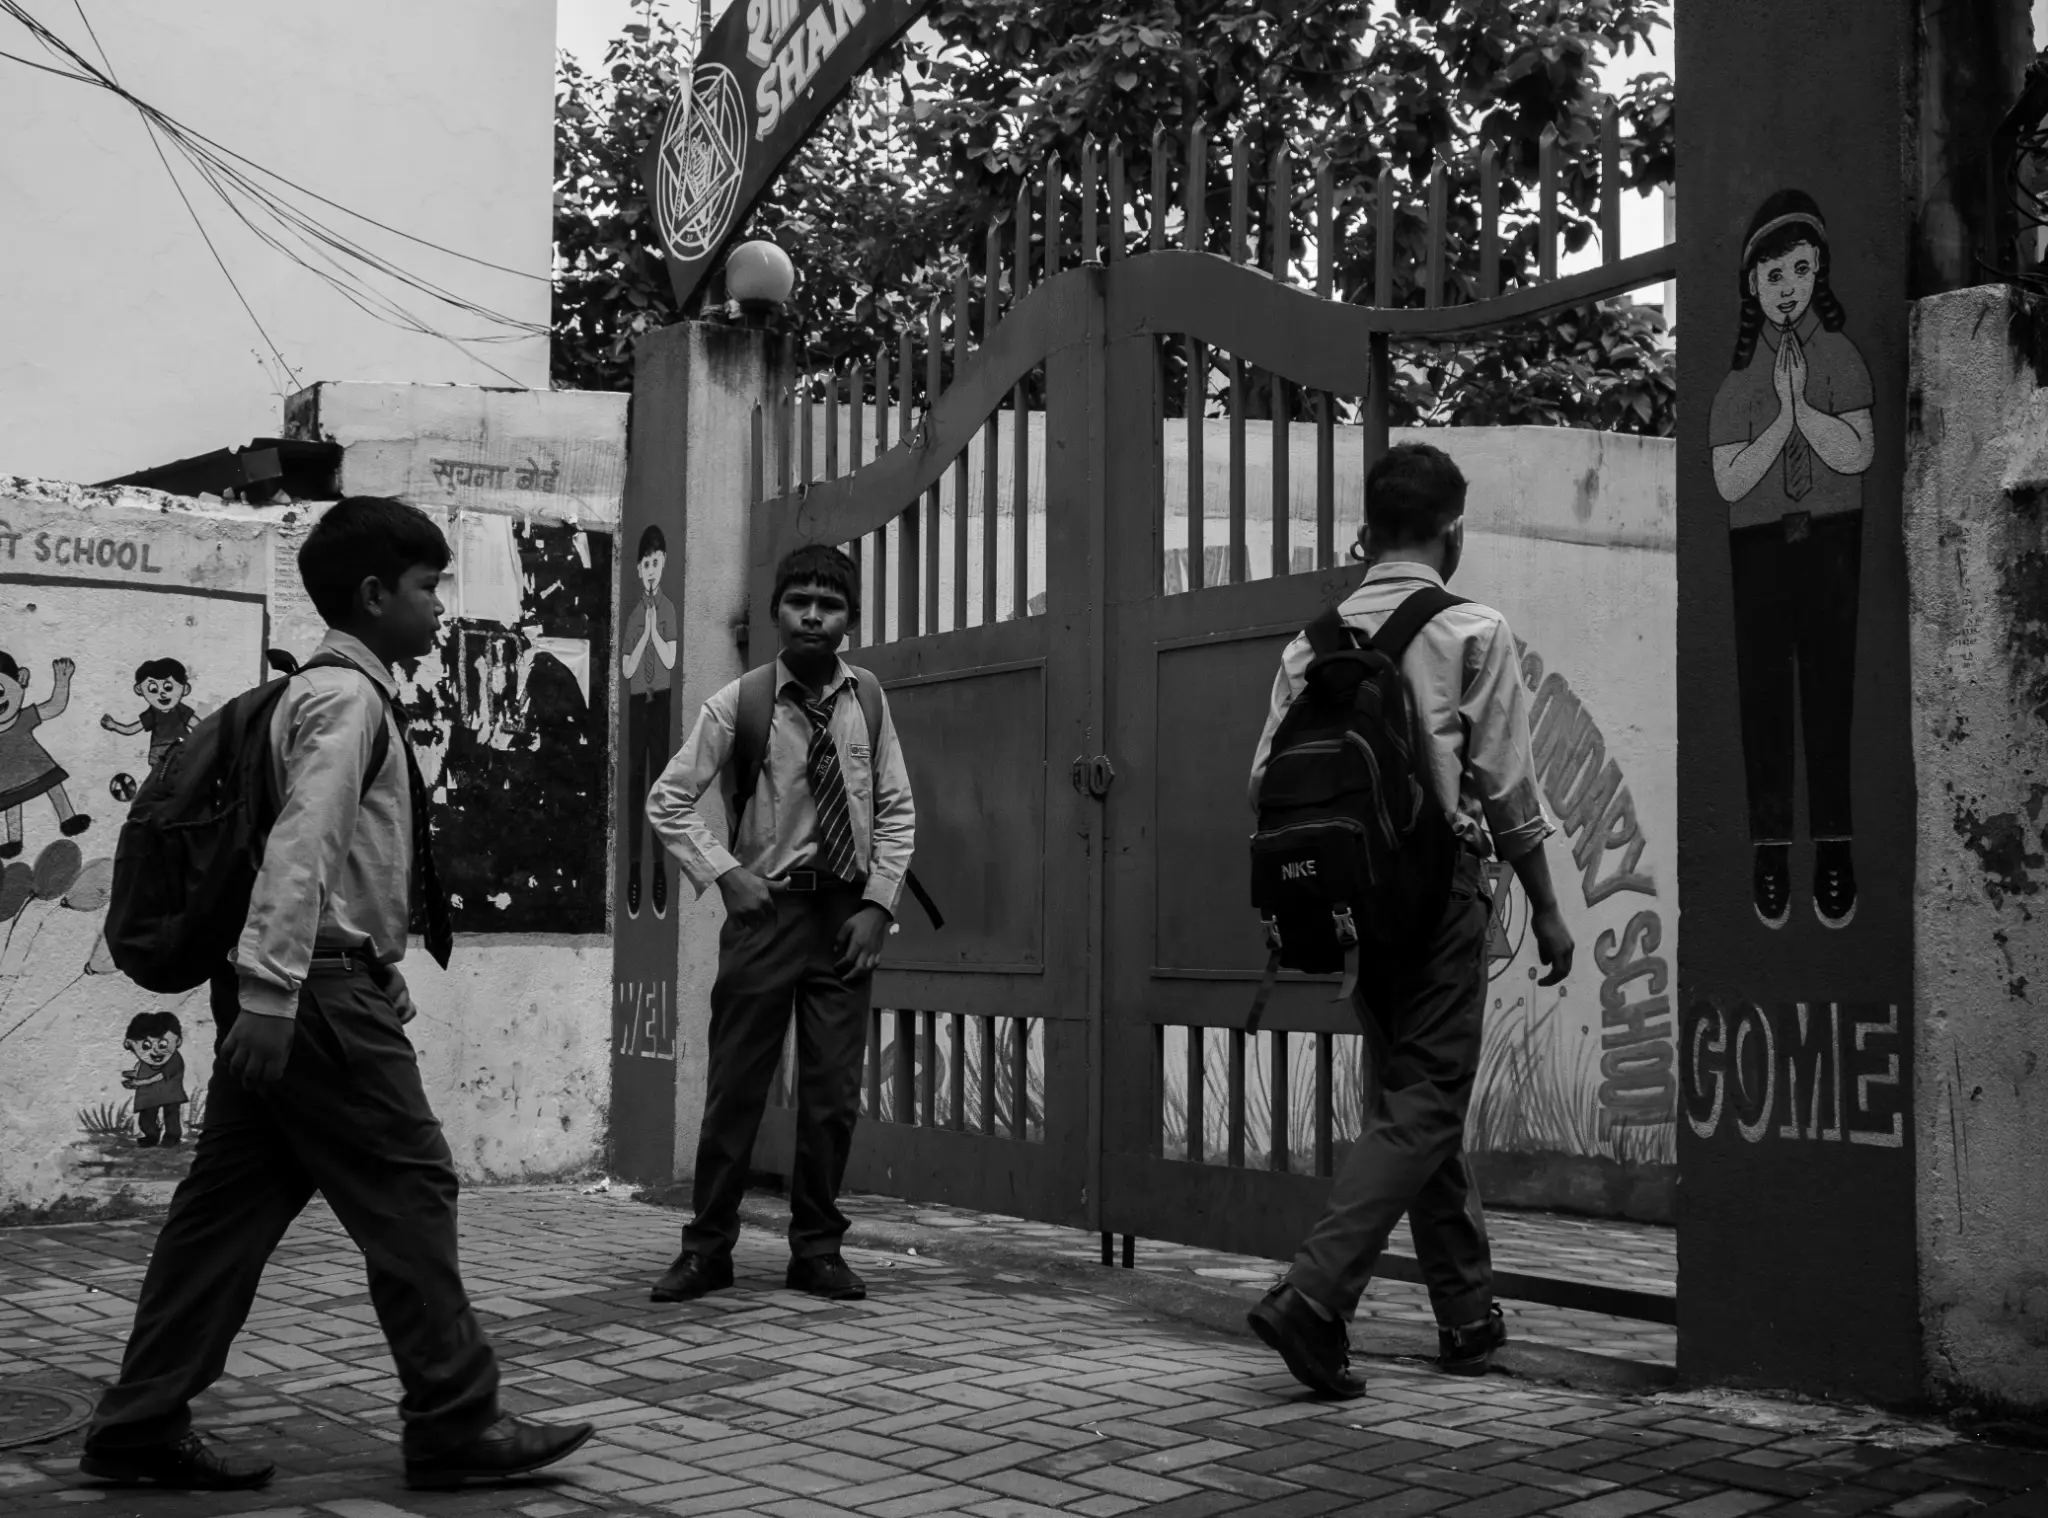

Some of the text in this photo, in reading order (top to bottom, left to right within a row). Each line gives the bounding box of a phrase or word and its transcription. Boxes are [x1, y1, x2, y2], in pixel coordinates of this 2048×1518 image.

[429, 456, 510, 497] सूचना
[33, 531, 163, 574] SCHOOL
[1281, 860, 1317, 880] NIKE
[1594, 909, 1677, 1142] SCHOOL
[1682, 1001, 1904, 1149] COME
